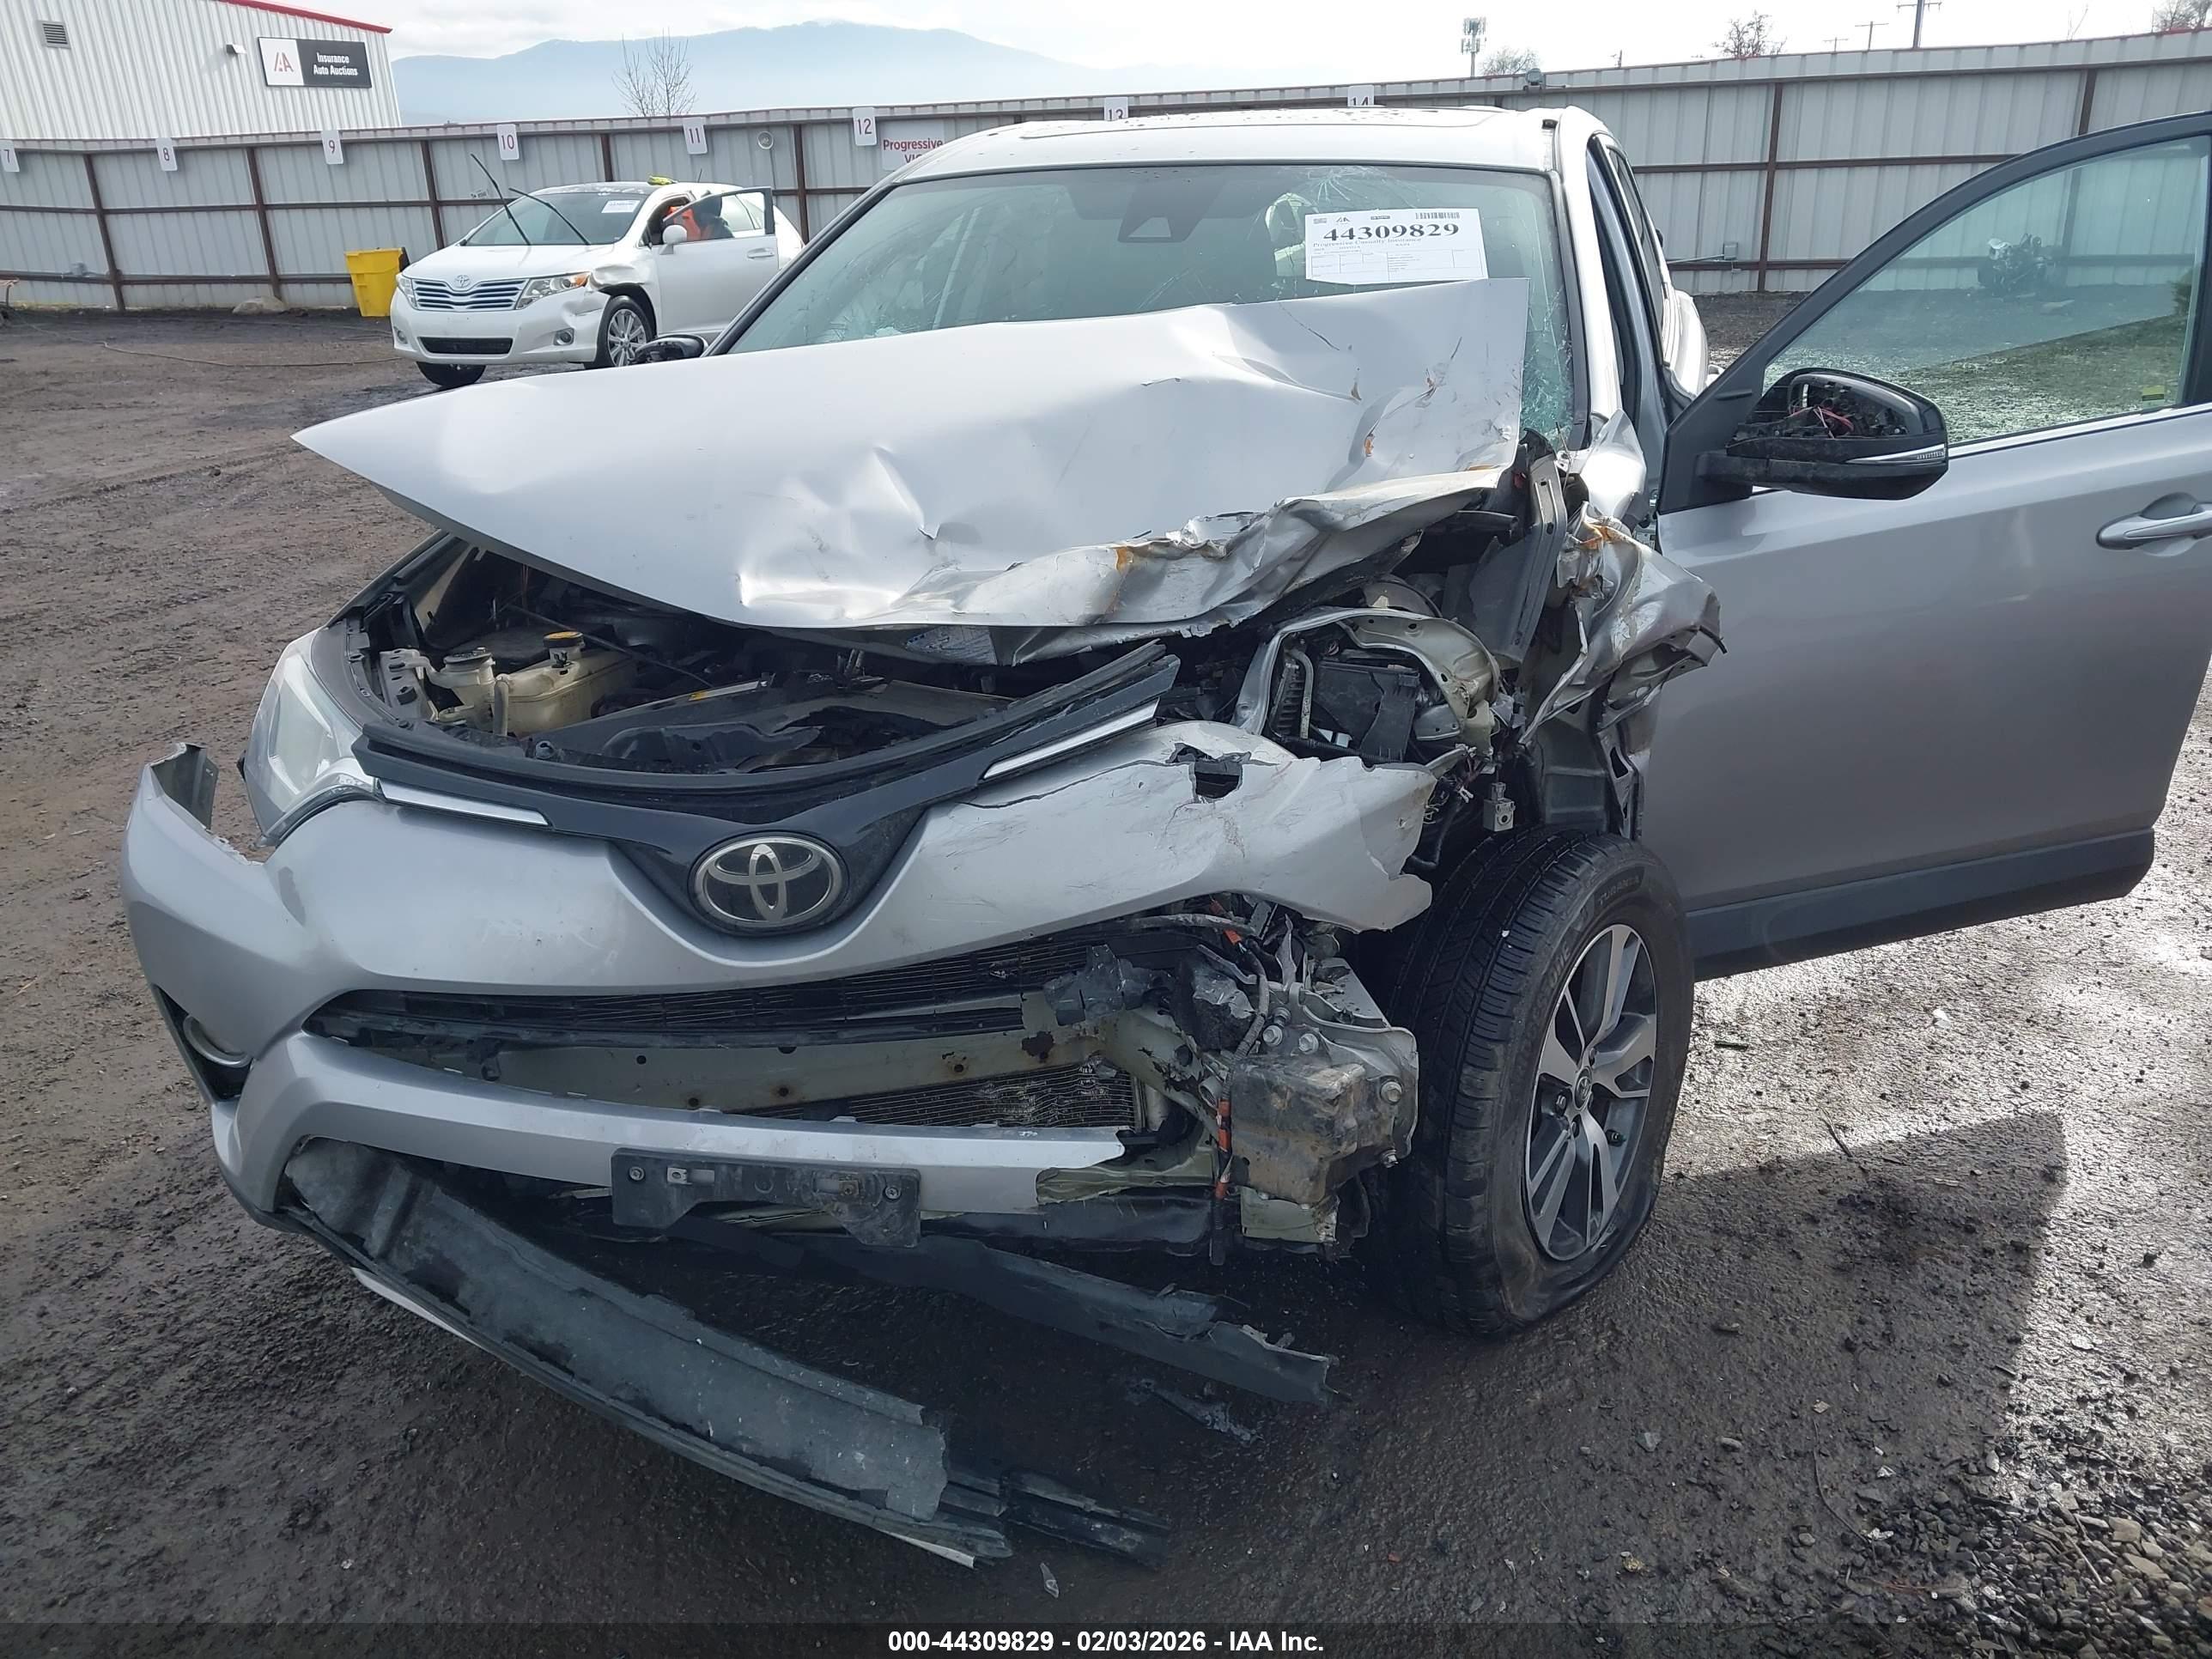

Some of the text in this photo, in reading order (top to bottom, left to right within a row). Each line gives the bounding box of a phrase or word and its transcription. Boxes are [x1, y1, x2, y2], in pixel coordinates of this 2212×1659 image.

[316, 52, 349, 64] Insurance
[313, 64, 358, 76] Auto Auctions
[858, 118, 872, 135] 12
[501, 134, 514, 150] 10
[689, 127, 700, 143] 11
[328, 139, 335, 154] 9
[883, 137, 943, 152] Progressive
[3, 149, 9, 163] 7
[163, 147, 170, 161] 8
[1323, 222, 1459, 241] 44309829
